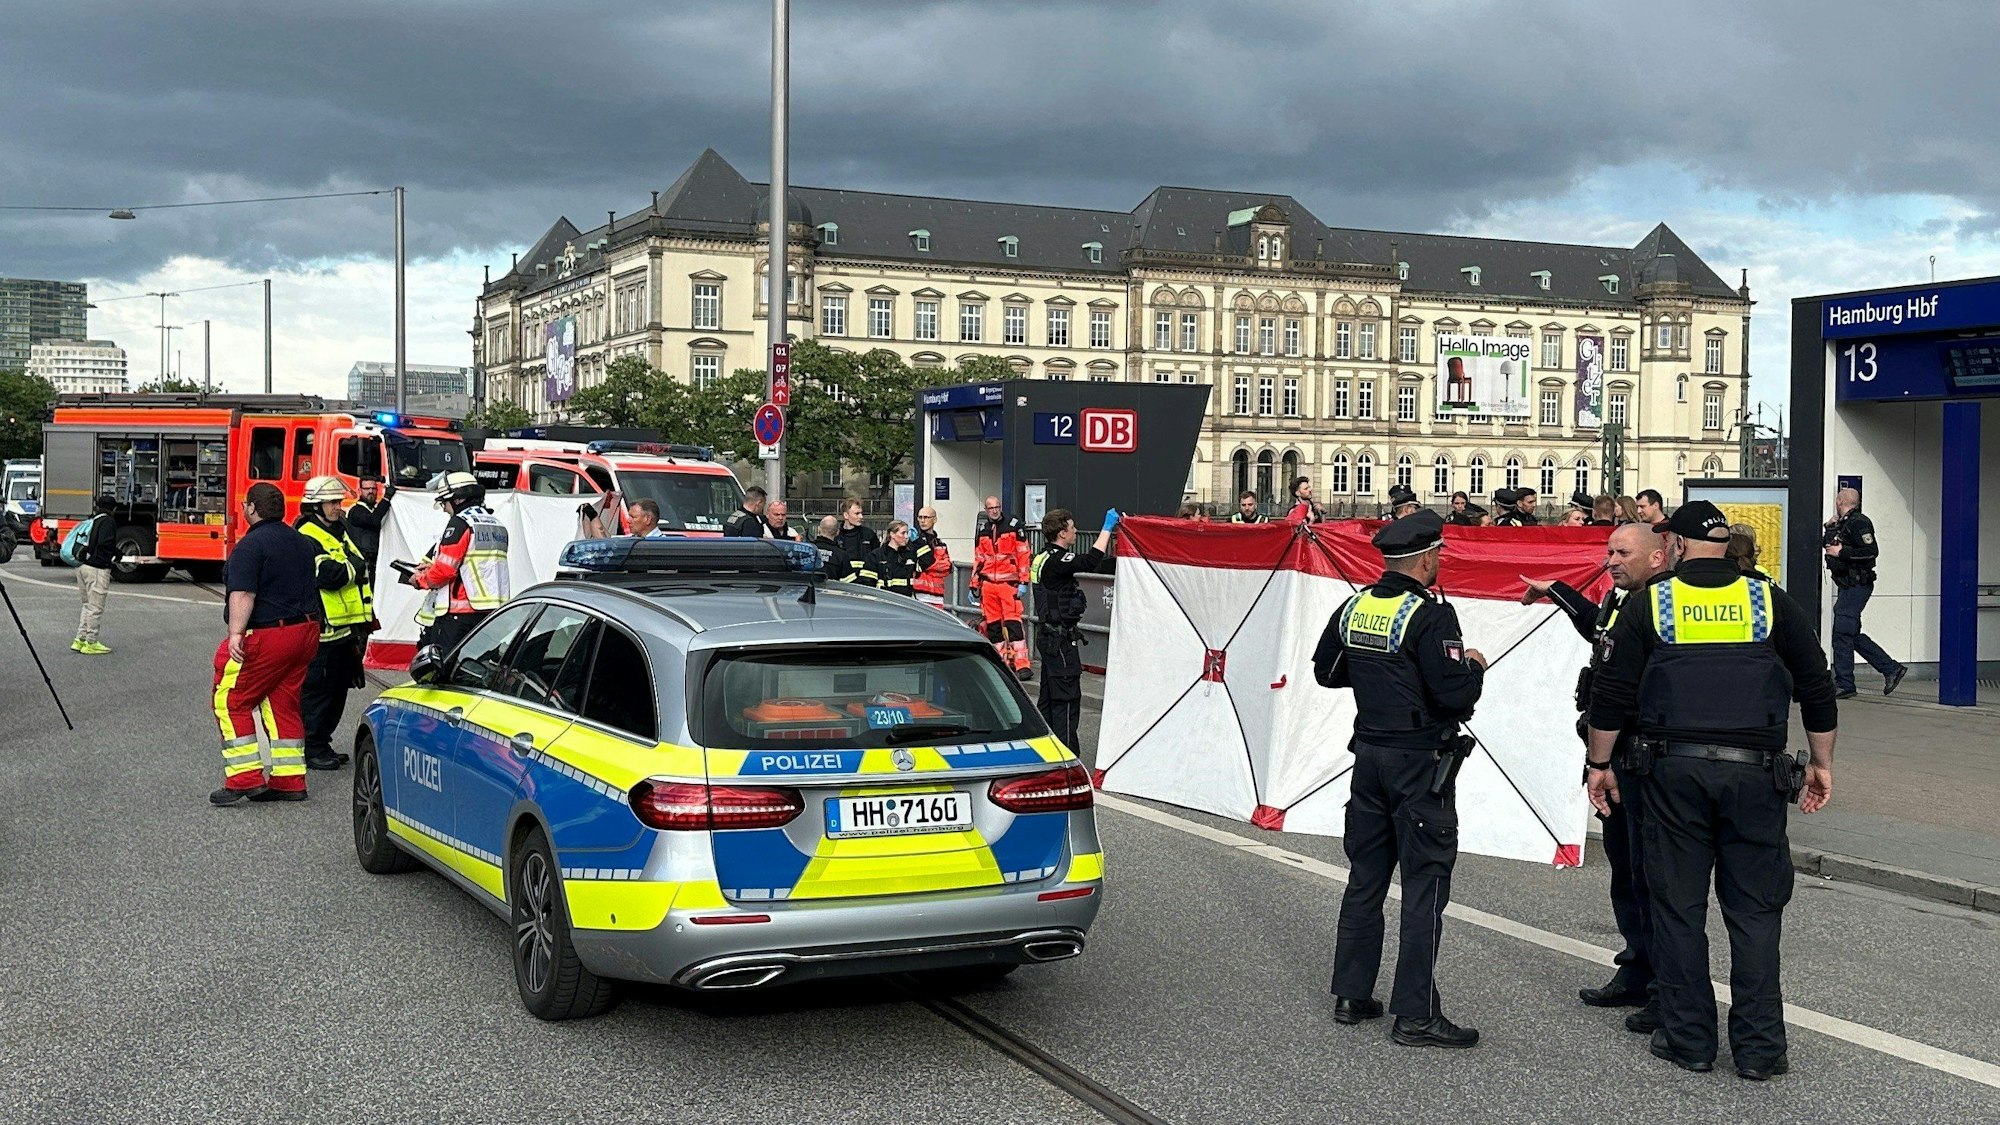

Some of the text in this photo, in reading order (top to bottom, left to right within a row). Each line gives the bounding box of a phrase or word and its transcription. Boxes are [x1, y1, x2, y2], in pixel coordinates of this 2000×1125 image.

[1829, 295, 1939, 326] Hamburg Hbf
[775, 347, 787, 356] 01
[1440, 337, 1529, 361] Hello Image
[775, 364, 787, 373] 07
[1844, 342, 1878, 382] 13
[1050, 415, 1073, 438] 12
[1089, 416, 1130, 445] DB
[444, 452, 452, 462] 6
[1701, 516, 1728, 528] POLIZ
[1351, 612, 1391, 633] POLIZEI
[1682, 605, 1743, 622] POLIZEI
[874, 709, 905, 726] 23/10
[404, 746, 442, 792] POLIZEI
[761, 754, 843, 771] POLIZEI
[852, 797, 958, 828] HH 7160
